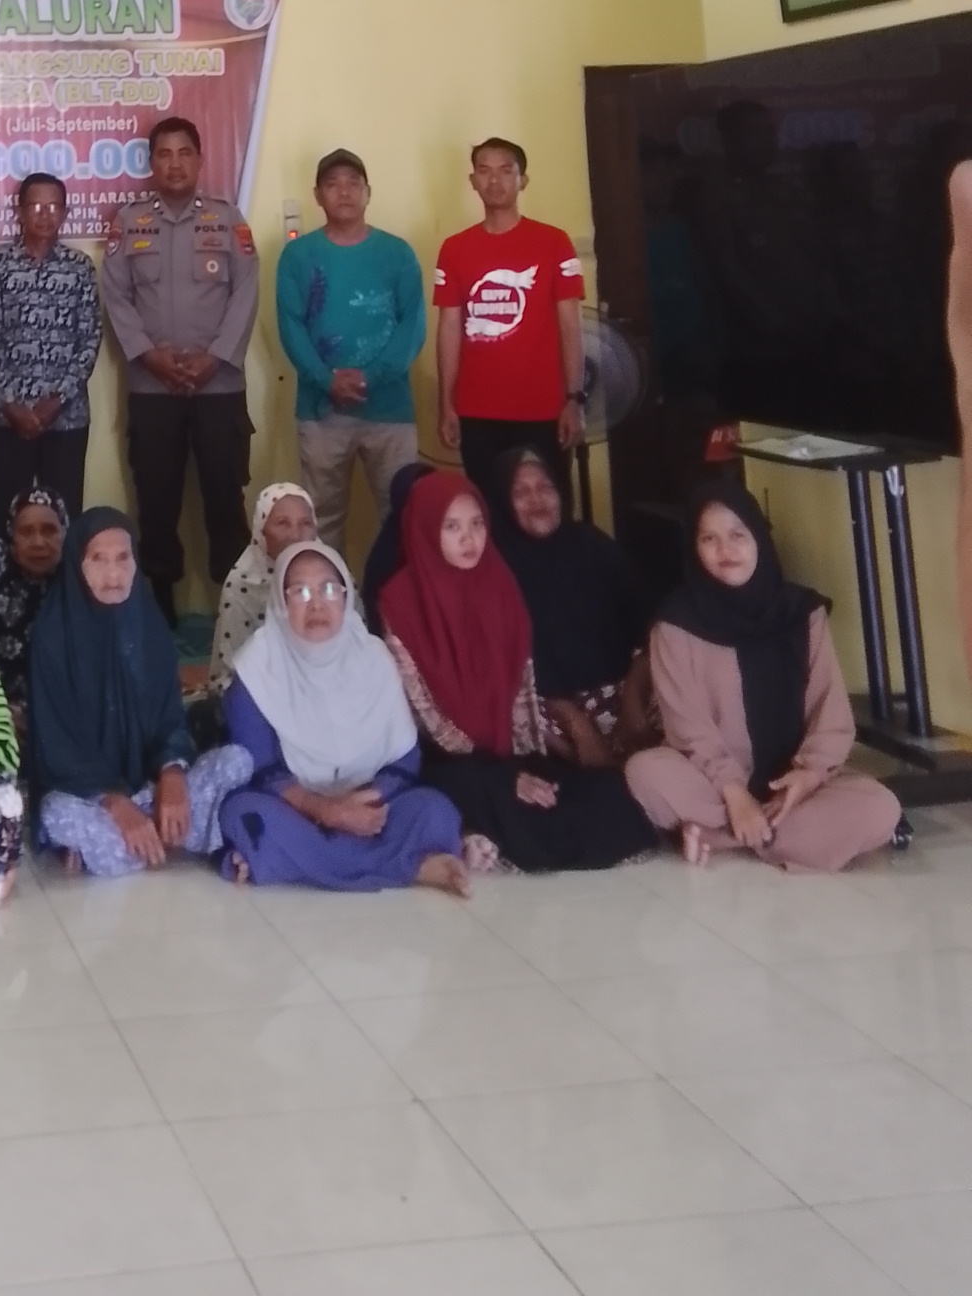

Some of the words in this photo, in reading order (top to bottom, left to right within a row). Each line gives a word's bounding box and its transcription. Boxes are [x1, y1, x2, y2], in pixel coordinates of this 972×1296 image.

[136, 49, 224, 75] TUNAI
[54, 78, 172, 110] (BLT-DD)
[6, 115, 138, 136] (Juli-September)
[90, 191, 136, 204] LARAS
